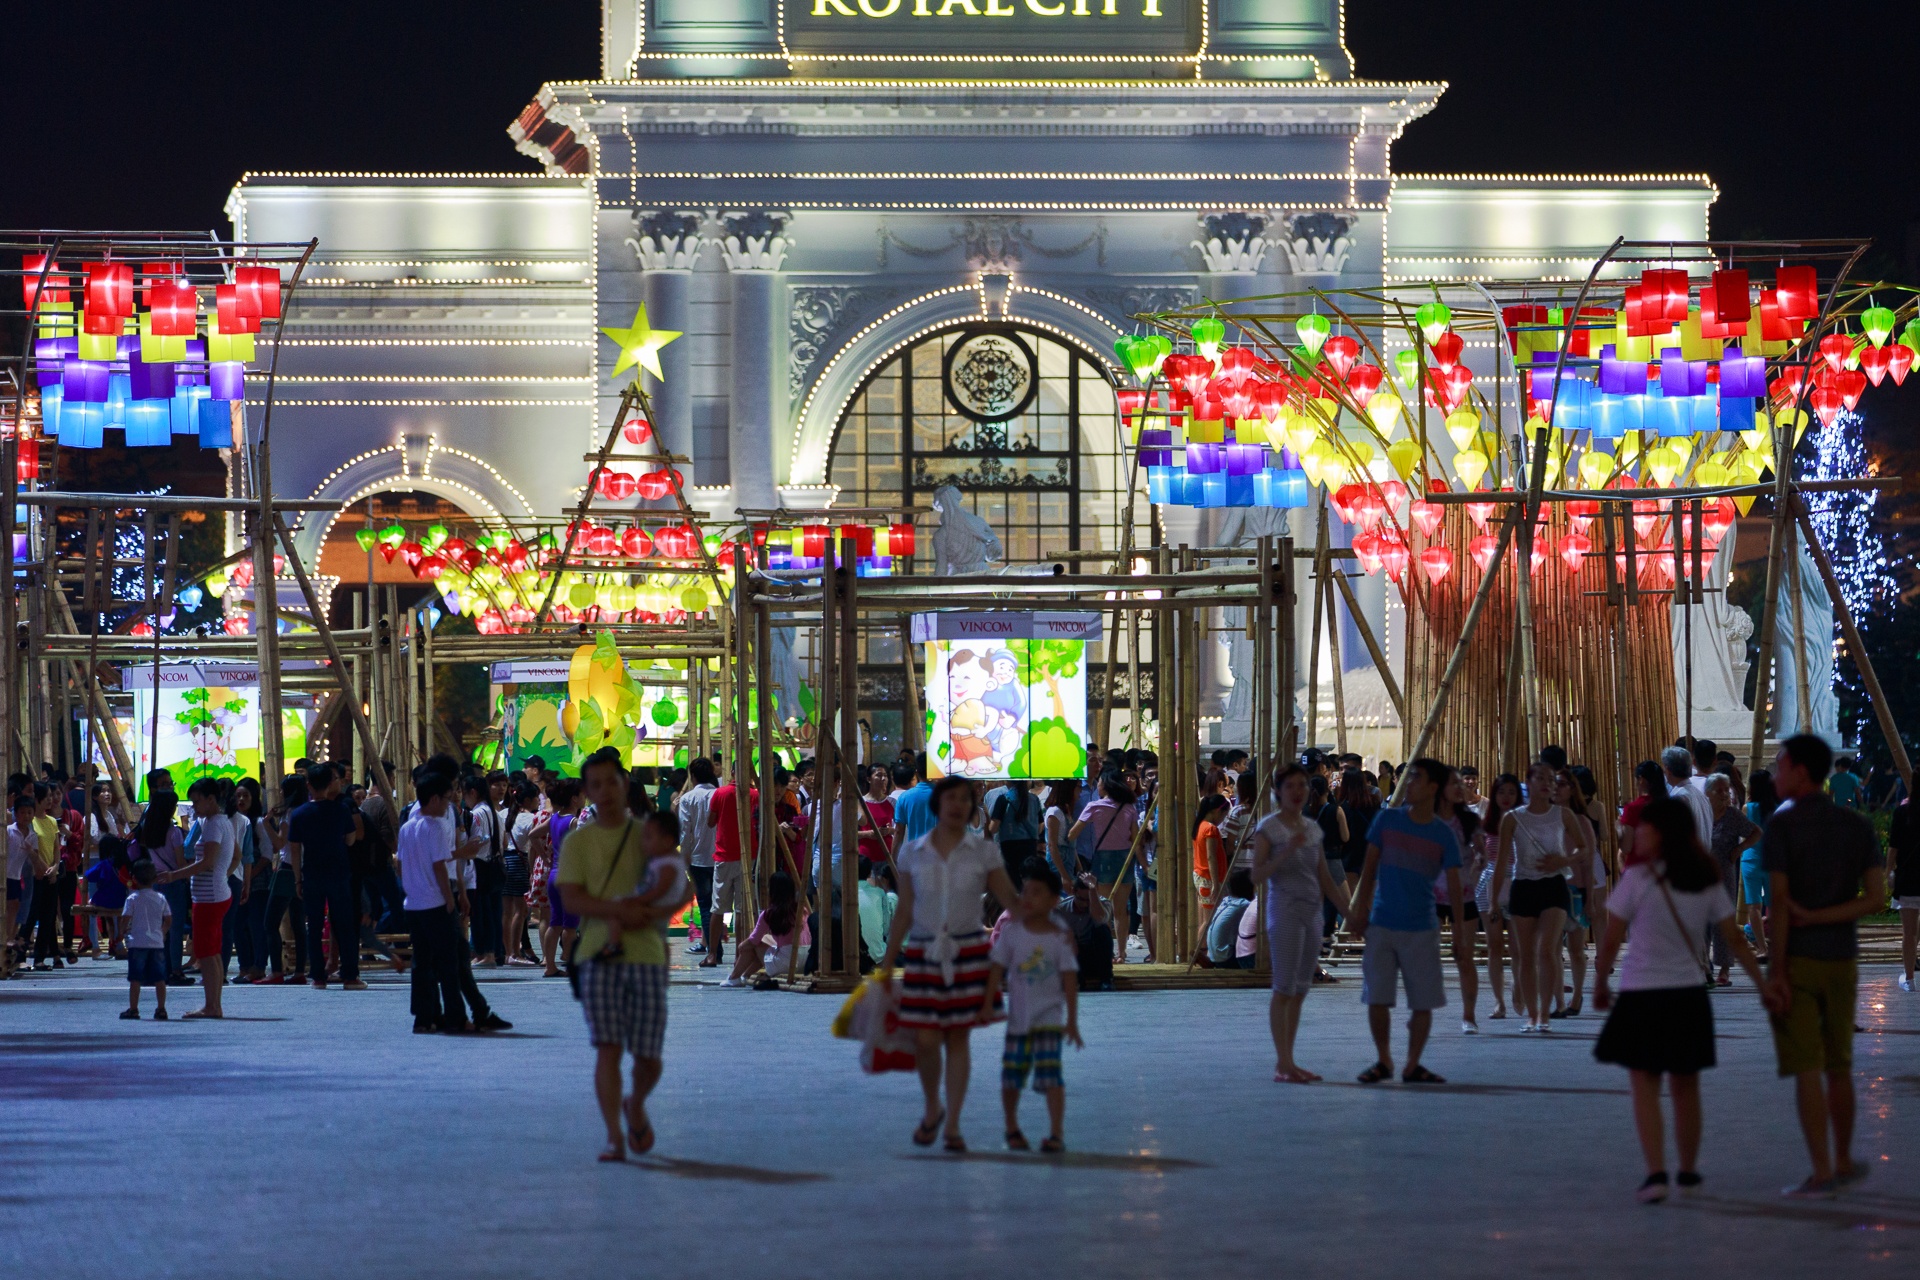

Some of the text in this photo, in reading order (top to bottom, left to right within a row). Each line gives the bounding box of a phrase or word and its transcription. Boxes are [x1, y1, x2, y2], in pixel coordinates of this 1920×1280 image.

[959, 621, 1013, 633] VINCOM
[1048, 621, 1087, 632] VINCOM
[220, 671, 257, 681] VINCOM
[527, 668, 566, 676] VINCOM
[147, 673, 189, 682] VNCOM
